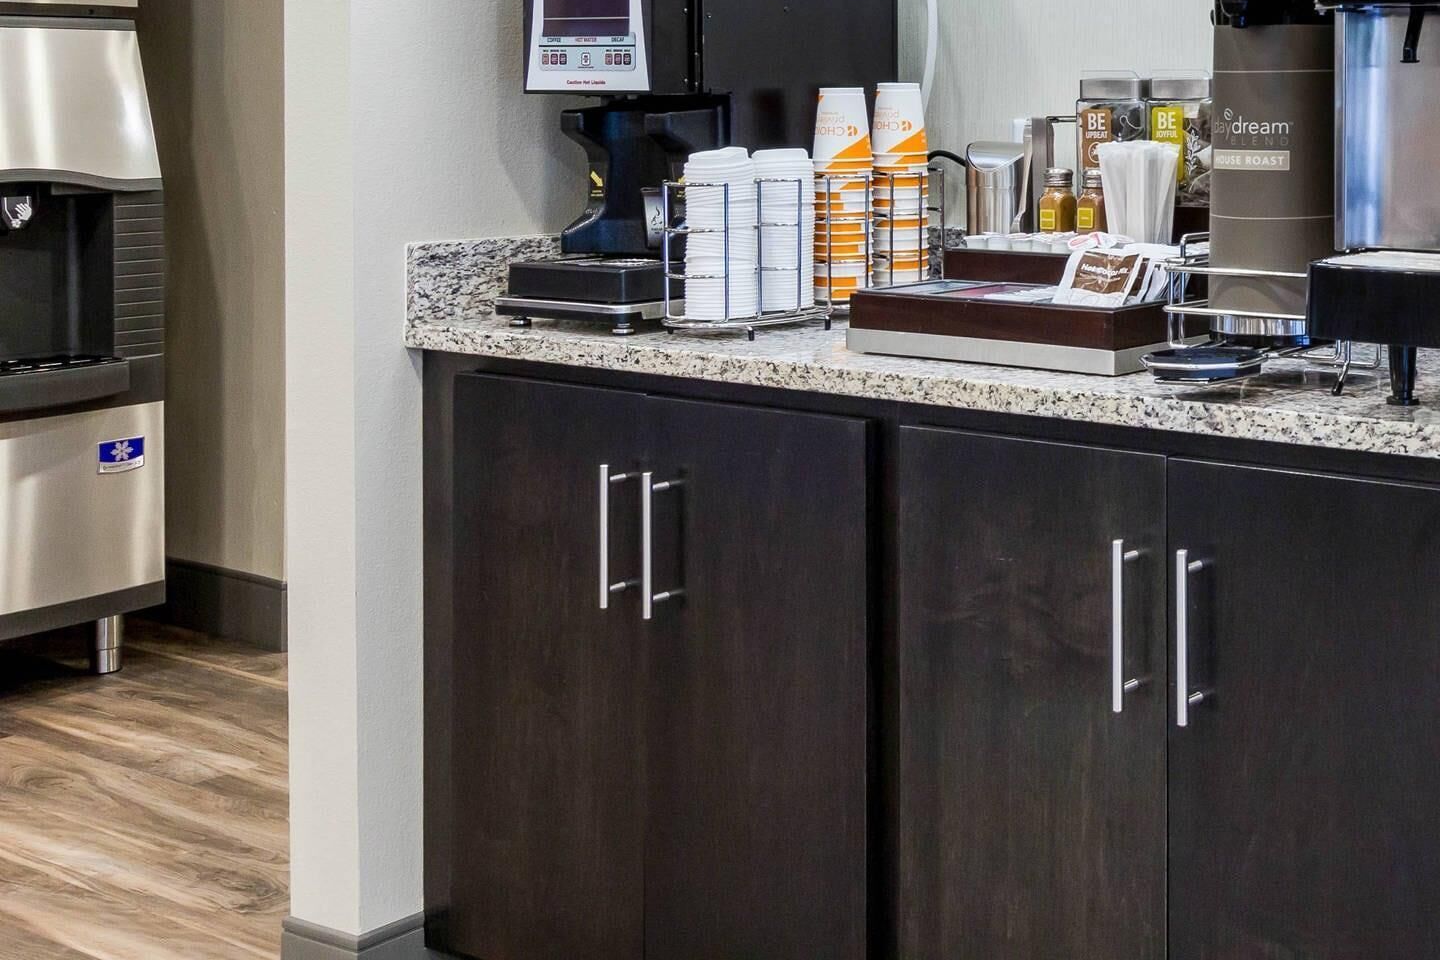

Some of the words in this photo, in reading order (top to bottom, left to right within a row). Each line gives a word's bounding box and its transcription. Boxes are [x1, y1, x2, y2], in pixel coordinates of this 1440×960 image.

[1087, 112, 1106, 130] BE
[1157, 111, 1176, 129] BE
[1085, 131, 1108, 139] UPBEAT
[1156, 129, 1178, 139] JOYFUL
[1231, 135, 1289, 146] BLEND
[1245, 155, 1285, 166] ROAST
